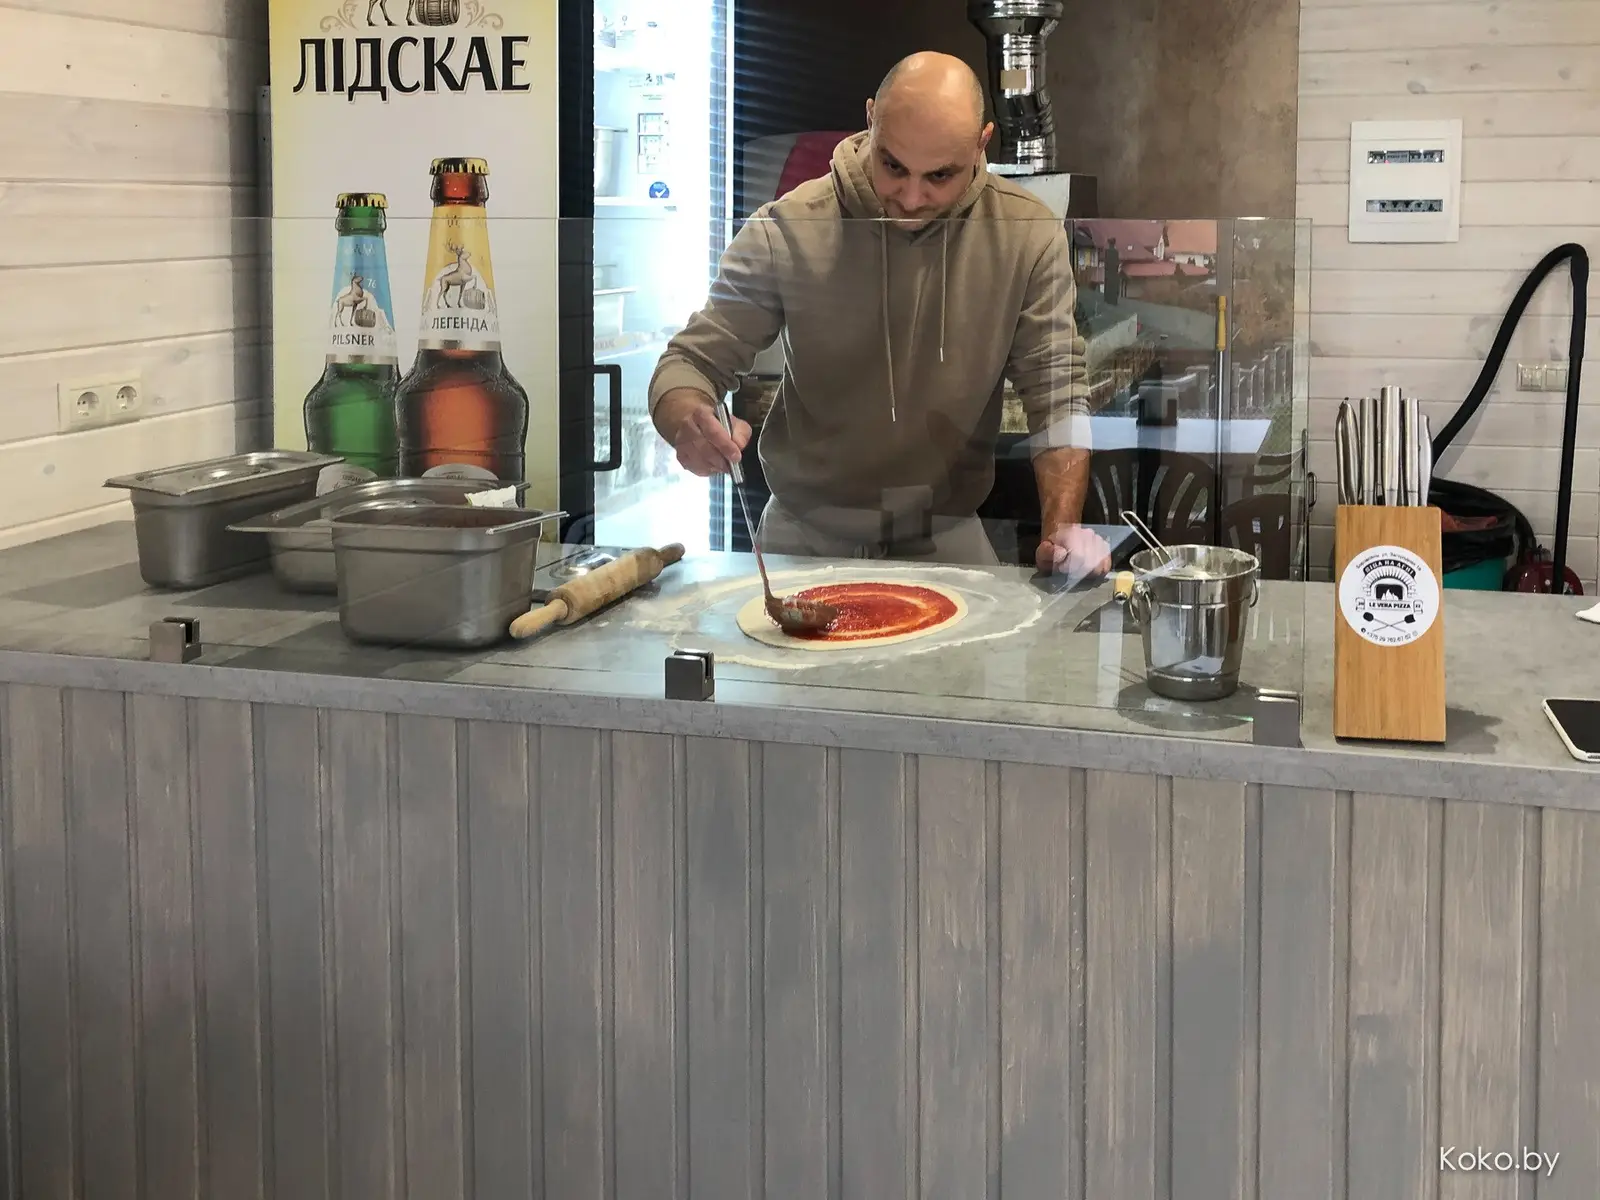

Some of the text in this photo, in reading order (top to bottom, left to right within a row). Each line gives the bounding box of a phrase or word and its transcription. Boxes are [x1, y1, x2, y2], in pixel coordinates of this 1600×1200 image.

[292, 35, 531, 103] ЛІДСКАЕ
[431, 316, 489, 332] ЛЕГЕНДА
[332, 333, 376, 346] PILSNER
